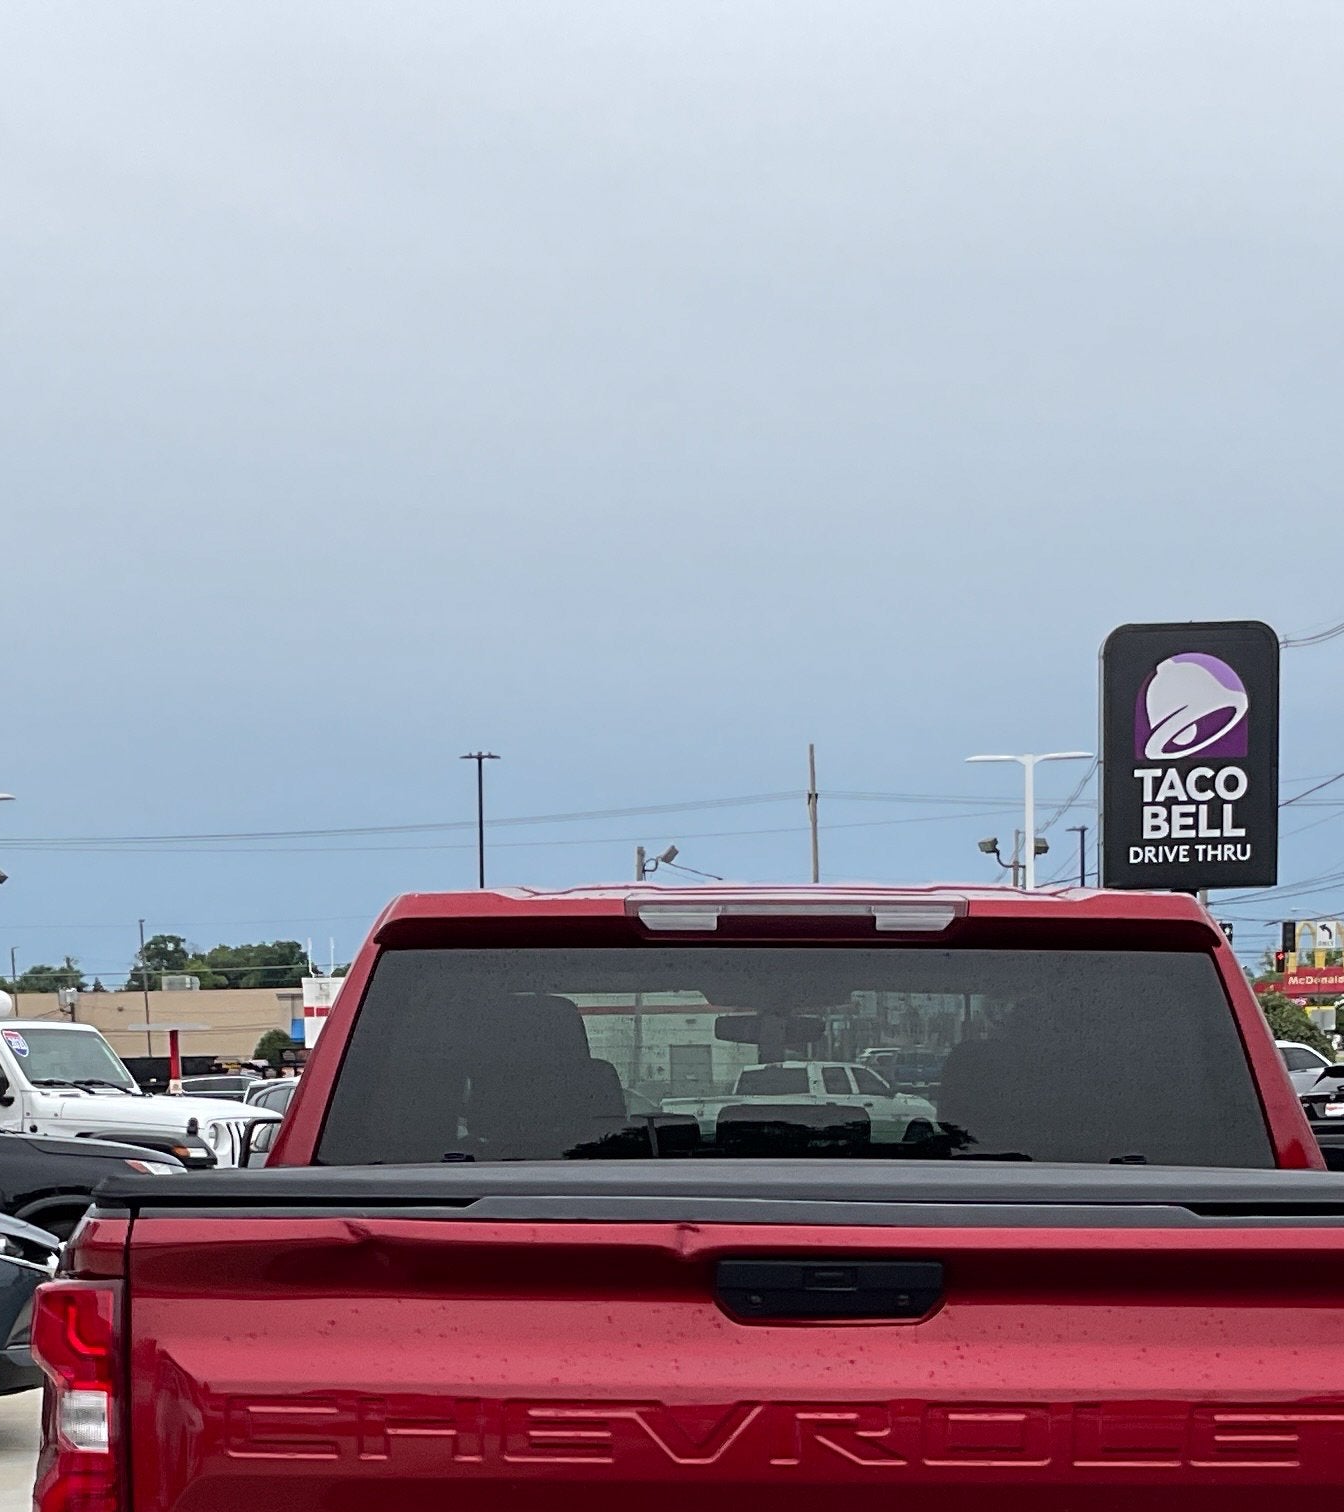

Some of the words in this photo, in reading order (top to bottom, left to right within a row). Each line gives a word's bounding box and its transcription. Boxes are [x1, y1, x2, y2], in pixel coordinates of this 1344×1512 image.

[1133, 765, 1248, 803] TACO
[1142, 803, 1246, 839] BELL
[1129, 845, 1190, 864] DRIVE
[1194, 843, 1251, 862] THRU
